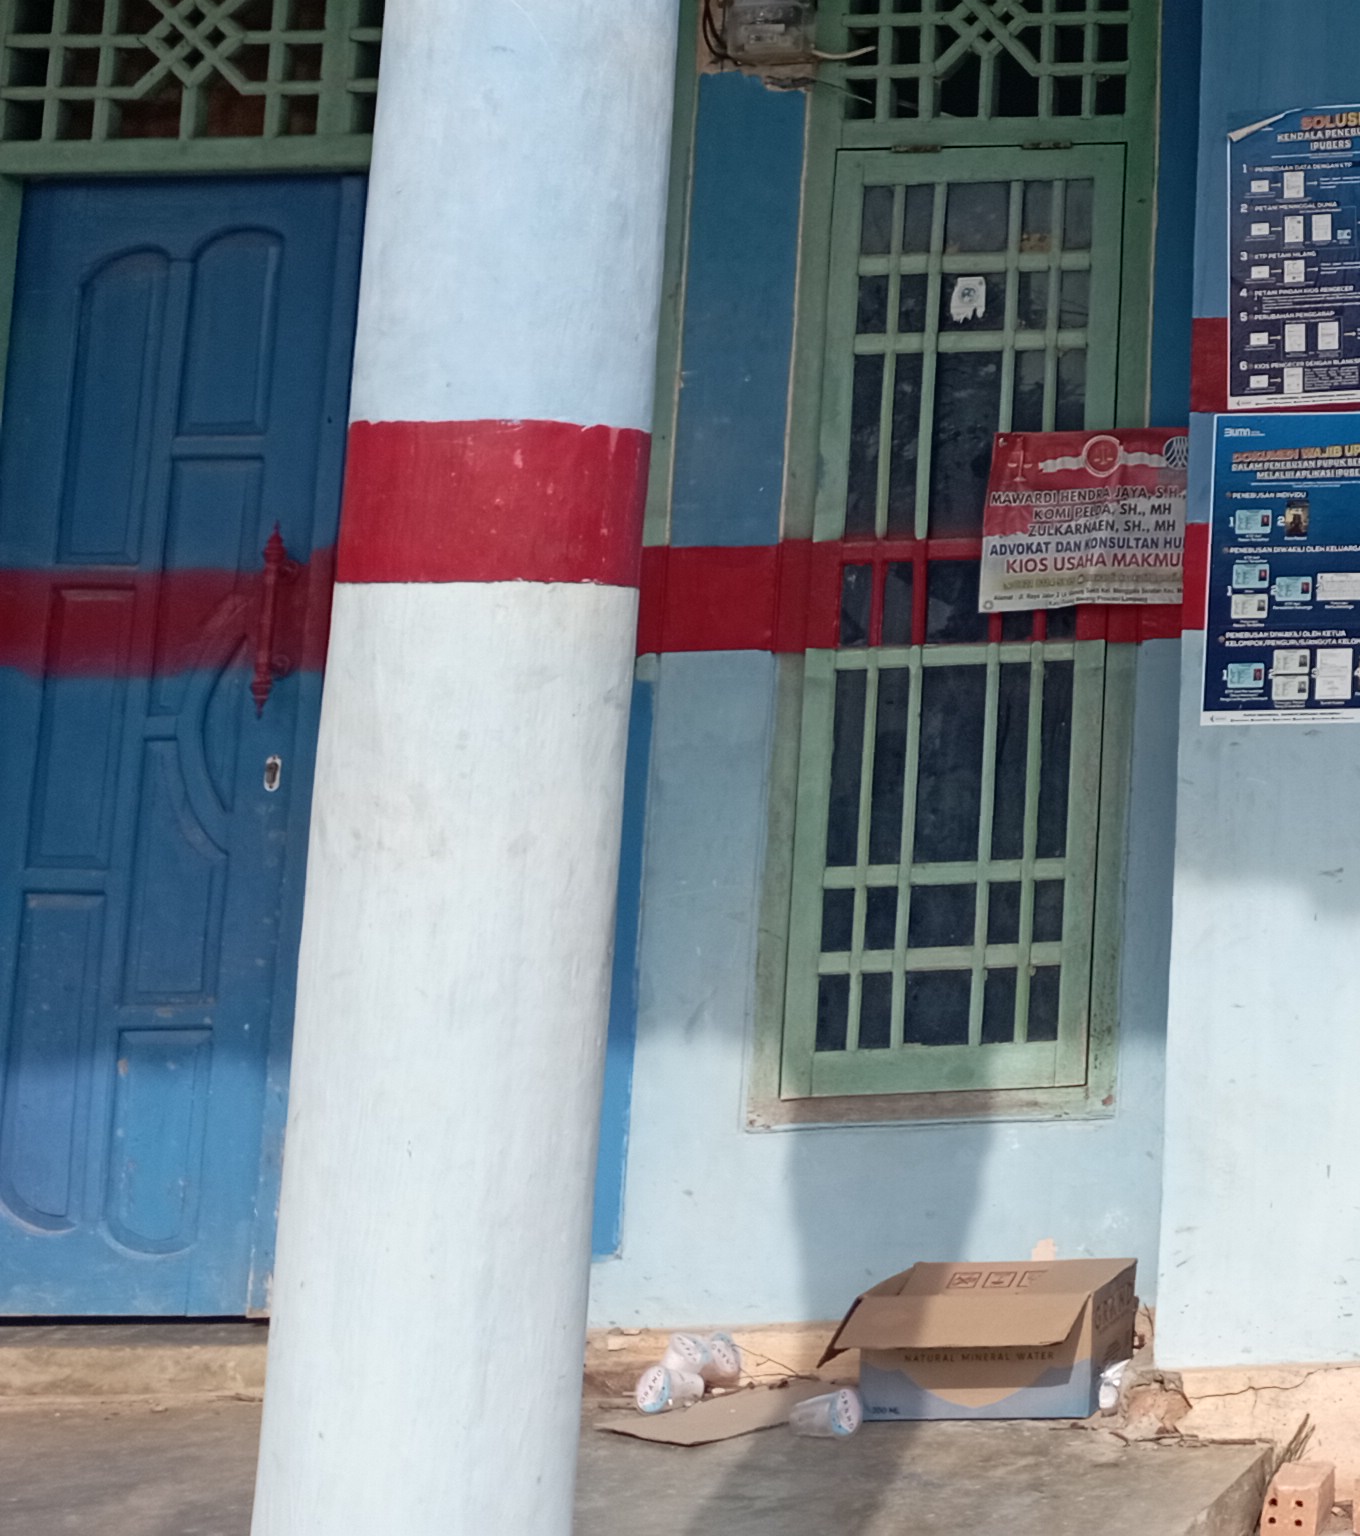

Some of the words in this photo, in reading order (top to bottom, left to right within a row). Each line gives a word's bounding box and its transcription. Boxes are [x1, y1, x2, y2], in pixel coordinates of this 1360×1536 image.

[1277, 130, 1324, 143] KENDALA
[1242, 164, 1248, 174] 1
[1240, 203, 1248, 213] 2
[1240, 251, 1248, 261] 3
[1239, 288, 1248, 297] 4
[1240, 312, 1248, 322] 5
[1239, 361, 1248, 370] 6
[1302, 445, 1342, 459] WAJIB
[990, 490, 1057, 505] MAWARDI
[1060, 488, 1110, 502] HENDRA
[1115, 486, 1151, 500] JAYA,
[1033, 507, 1071, 521] KOMI
[1119, 503, 1146, 516] SH.,
[1150, 503, 1172, 515] MH
[1277, 516, 1285, 527] 2
[1028, 519, 1119, 537] ZULKARNAEN,
[1123, 520, 1150, 533] SH.,
[1154, 520, 1176, 532] MH
[989, 541, 1052, 556] ADVOKAT
[1055, 540, 1081, 553] DAN
[1084, 537, 1160, 551] KONSULTAN
[1006, 557, 1048, 574] KIOS
[1054, 553, 1107, 571] USAHA
[1111, 553, 1184, 569] MAKMU
[904, 1353, 955, 1362] NATURAL
[960, 1351, 1010, 1361] MINERAL
[1015, 1350, 1054, 1360] WATER
